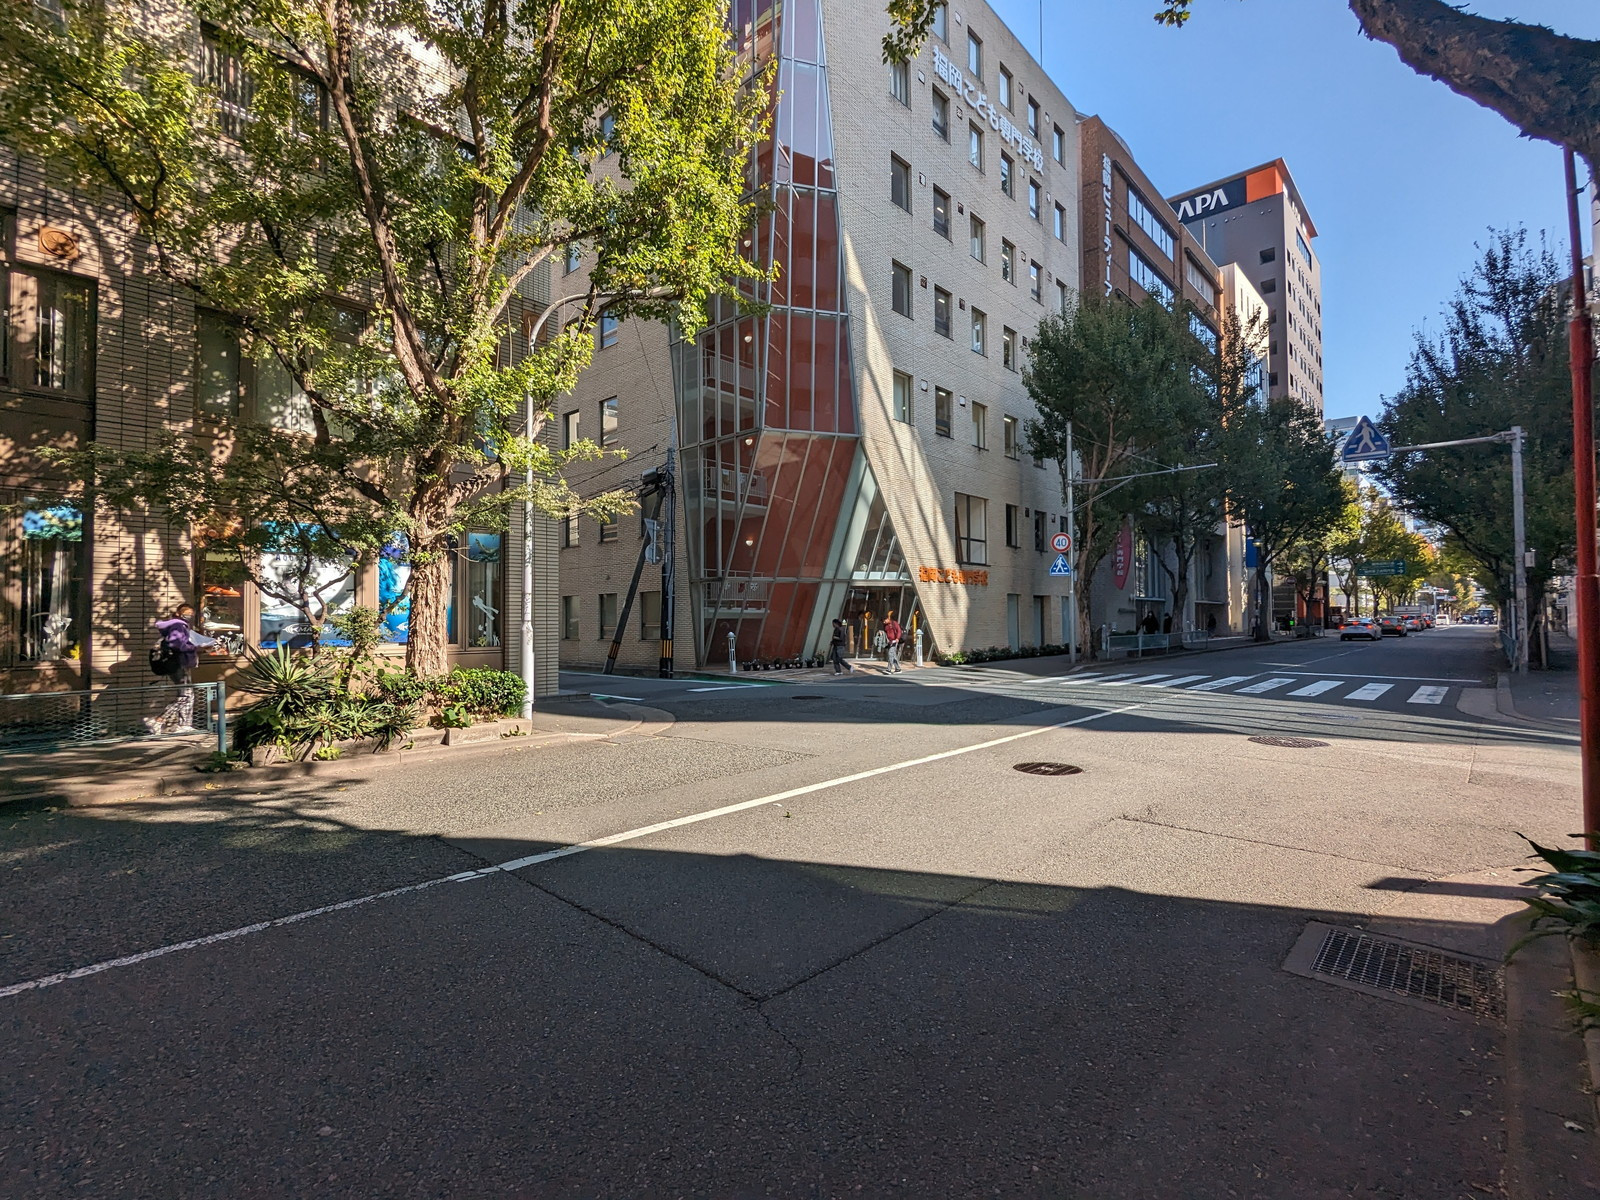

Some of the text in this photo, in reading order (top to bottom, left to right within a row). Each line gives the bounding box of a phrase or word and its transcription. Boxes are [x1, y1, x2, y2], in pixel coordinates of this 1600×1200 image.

[932, 45, 1044, 176] 福岡こども専門学校
[1177, 188, 1229, 222] APA
[1102, 152, 1113, 304] 福岡ビューティーア
[1055, 537, 1067, 548] 40
[919, 565, 989, 586] 福岡こども専門学校
